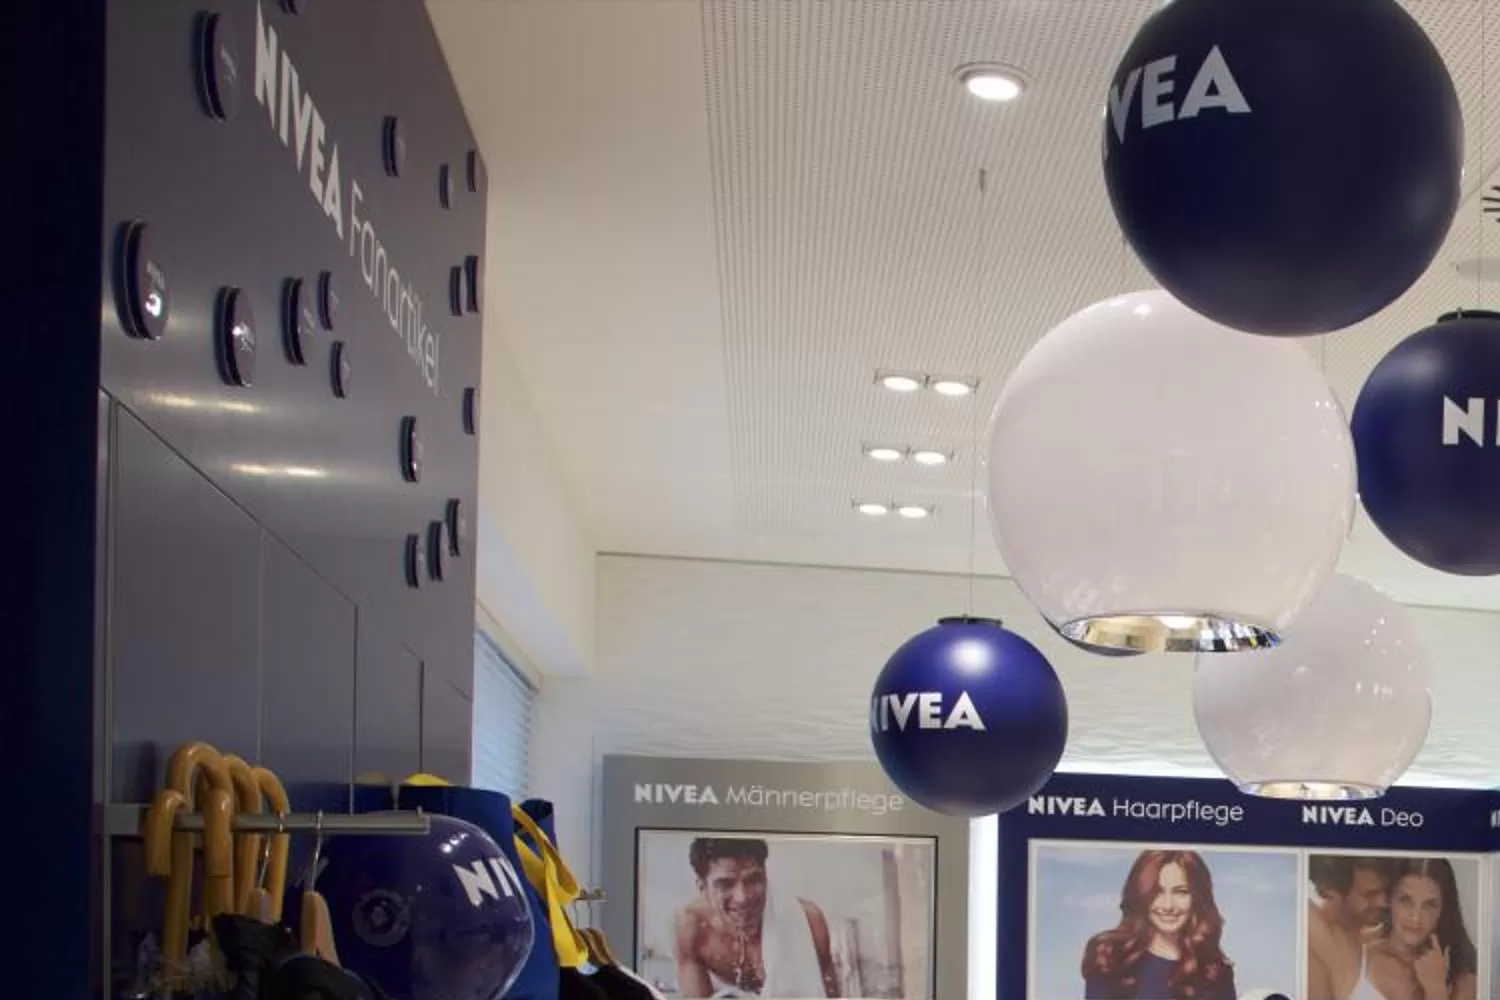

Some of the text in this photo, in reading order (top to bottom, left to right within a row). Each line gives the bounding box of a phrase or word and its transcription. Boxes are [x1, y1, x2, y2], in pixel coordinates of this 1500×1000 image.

[255, 0, 440, 396] NIVEA Fanartikel
[633, 783, 905, 815] NIVEA Männerpflege
[1027, 794, 1244, 826] NIVEA Haarpflege
[1301, 805, 1425, 827] NIVEA Deo
